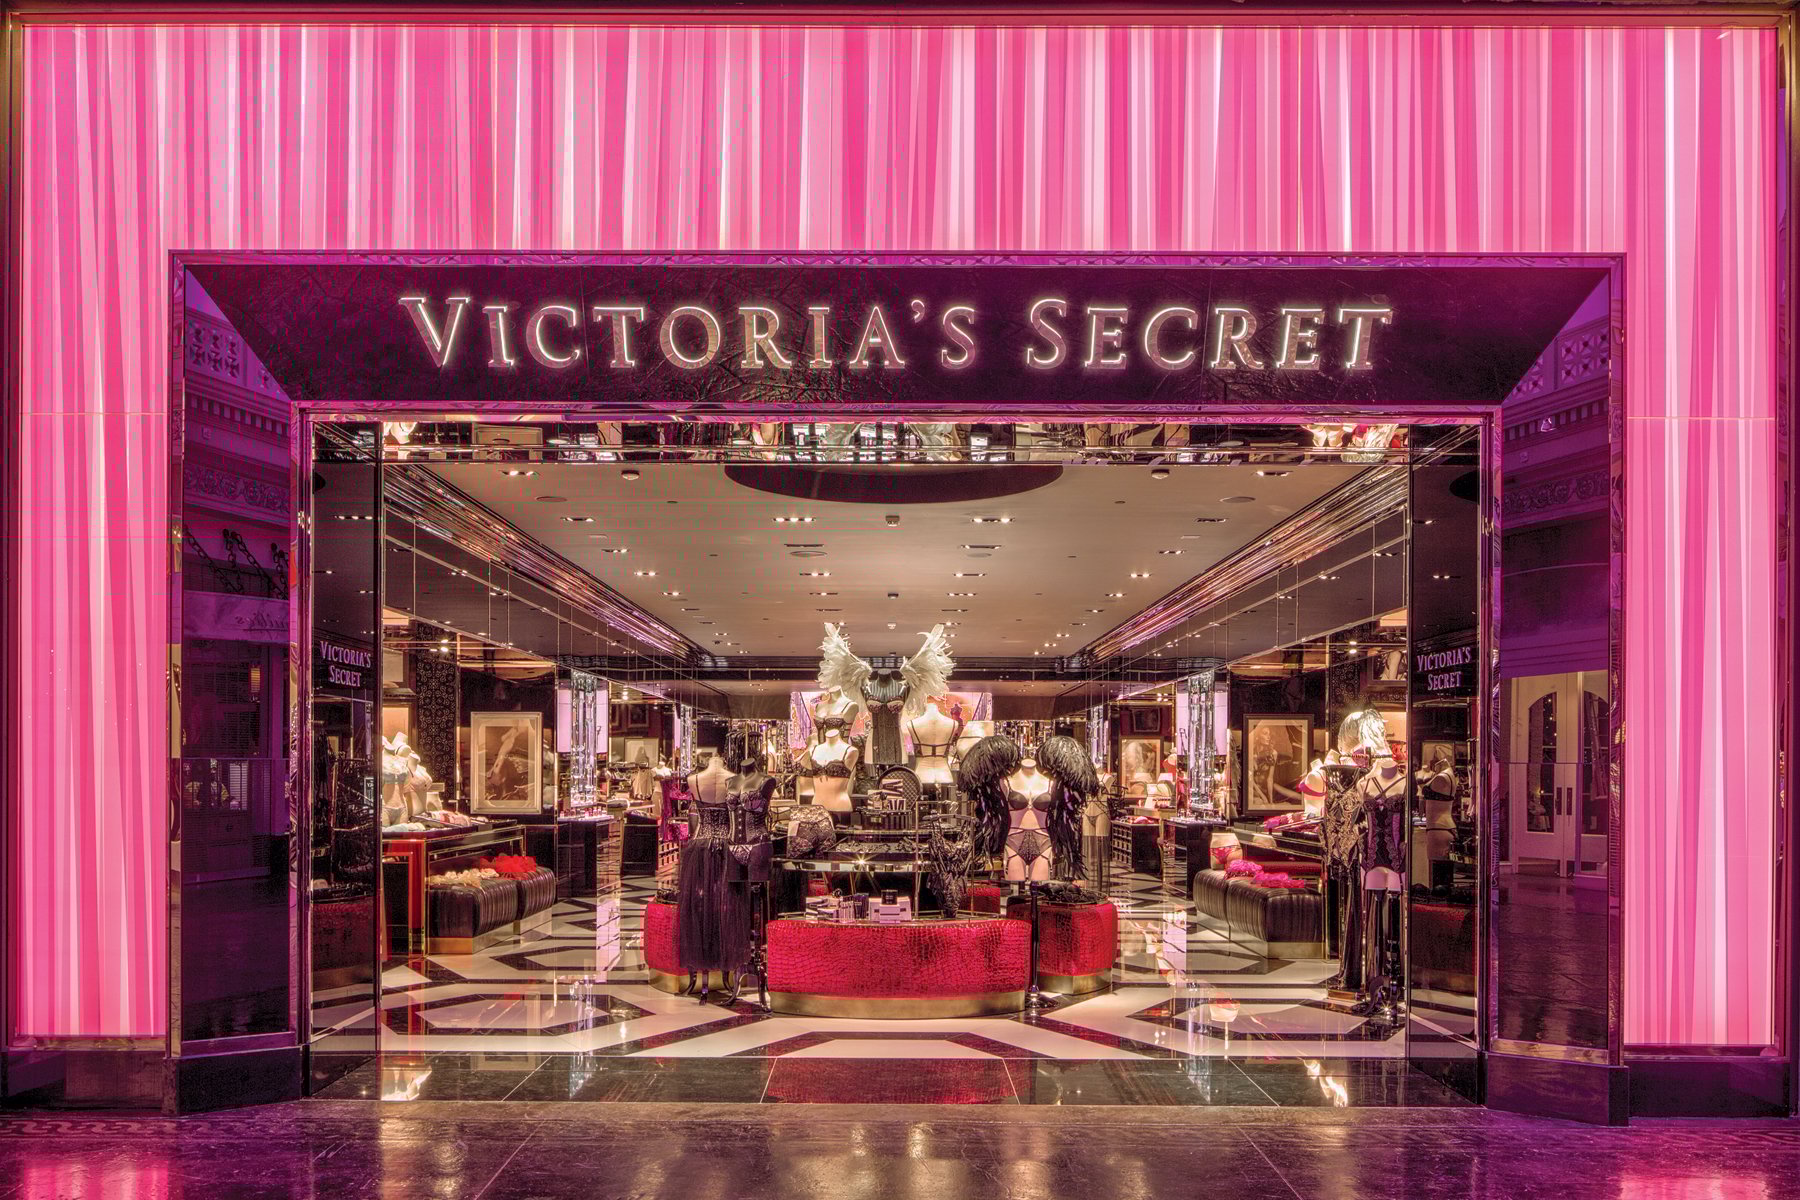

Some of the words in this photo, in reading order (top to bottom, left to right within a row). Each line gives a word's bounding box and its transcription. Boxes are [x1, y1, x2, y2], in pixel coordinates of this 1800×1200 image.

[398, 297, 976, 370] VICTORIA'S
[1027, 297, 1394, 370] SECRET
[320, 641, 371, 668] VICTORIA'S
[1417, 647, 1471, 671] VICTORIA'S
[329, 665, 361, 687] SECRET
[1428, 671, 1461, 690] SECRET
